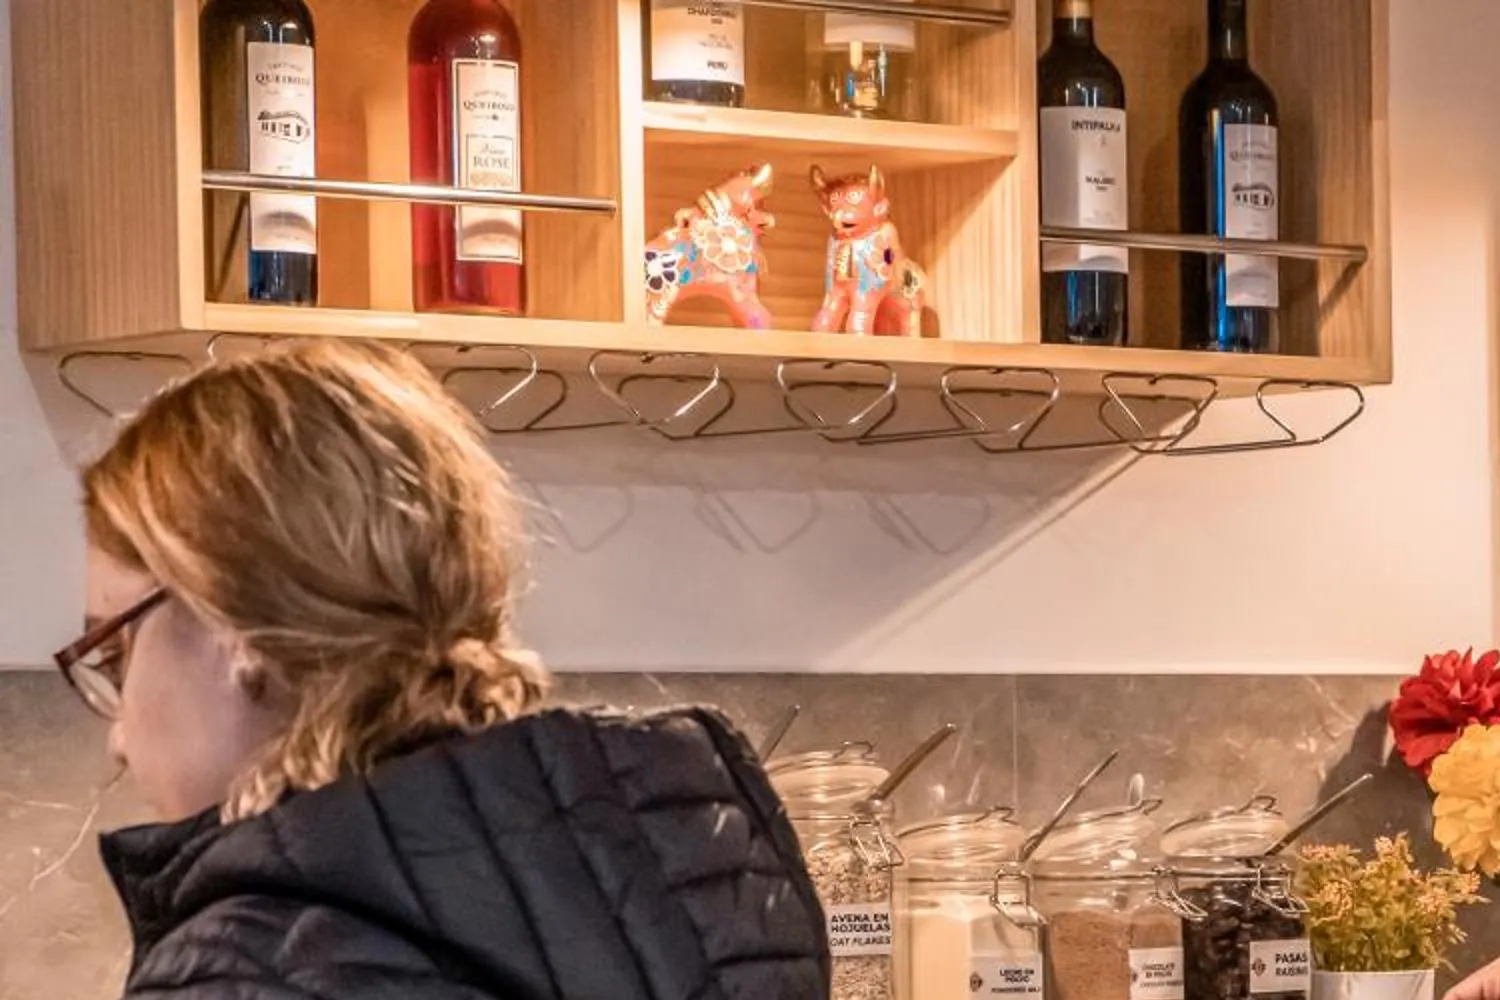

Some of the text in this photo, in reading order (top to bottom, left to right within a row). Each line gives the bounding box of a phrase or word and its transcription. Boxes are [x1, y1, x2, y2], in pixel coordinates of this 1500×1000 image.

[832, 913, 889, 922] AVENA EN
[831, 923, 890, 932] HOJUELAS
[831, 938, 850, 947] OAT
[1275, 953, 1307, 963] PASAS
